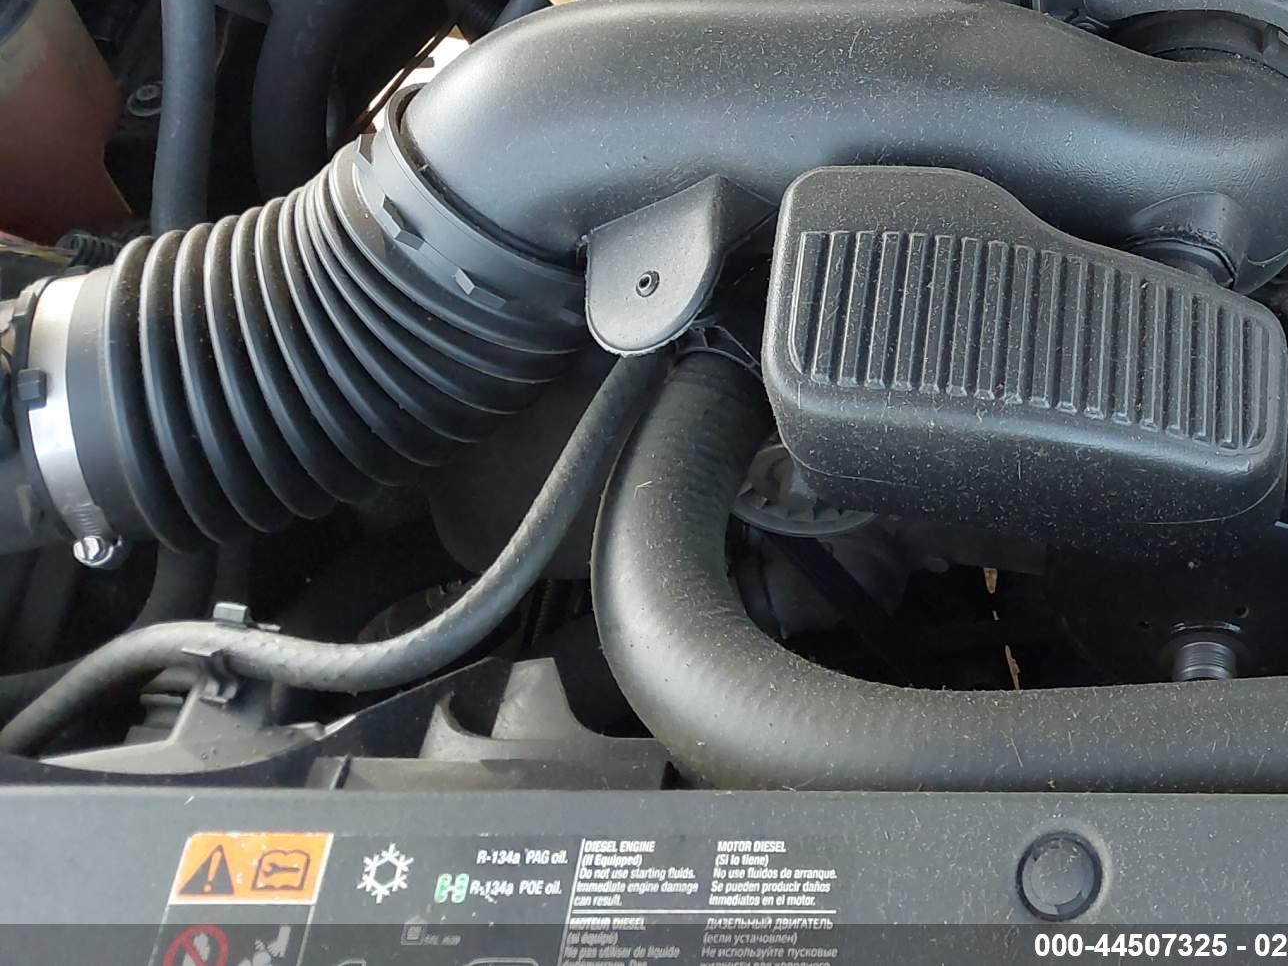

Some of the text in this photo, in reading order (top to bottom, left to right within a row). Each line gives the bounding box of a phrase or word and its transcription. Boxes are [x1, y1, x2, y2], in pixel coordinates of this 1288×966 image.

[584, 840, 656, 853] DIESEL ENGINE
[717, 840, 787, 853] MOTOR DIESEL
[476, 849, 569, 865] R-134a PAG oil.
[594, 854, 643, 868] Equipped)
[715, 854, 769, 867] (Si lo tiene)
[578, 867, 696, 881] Do not use starting fluids.
[712, 867, 837, 881] No use fluidos de arranque.
[469, 879, 562, 897] R-134a POE oil.
[576, 881, 699, 895] Immediate engine damage
[710, 880, 831, 895] Se pueden producir daños
[574, 893, 622, 906] can result.
[708, 894, 816, 906] inmediatos en el motor.
[569, 917, 646, 930] MOTEUR DIESEL
[704, 916, 834, 933] ДИЗЕЛЬНЫЙ ДВИГАТЕЛЬ
[703, 932, 798, 945] (если установлен)
[598, 945, 632, 958] utiliser
[632, 946, 647, 958] de
[647, 945, 681, 959] liquide
[701, 945, 838, 962] Не используйте пусковые
